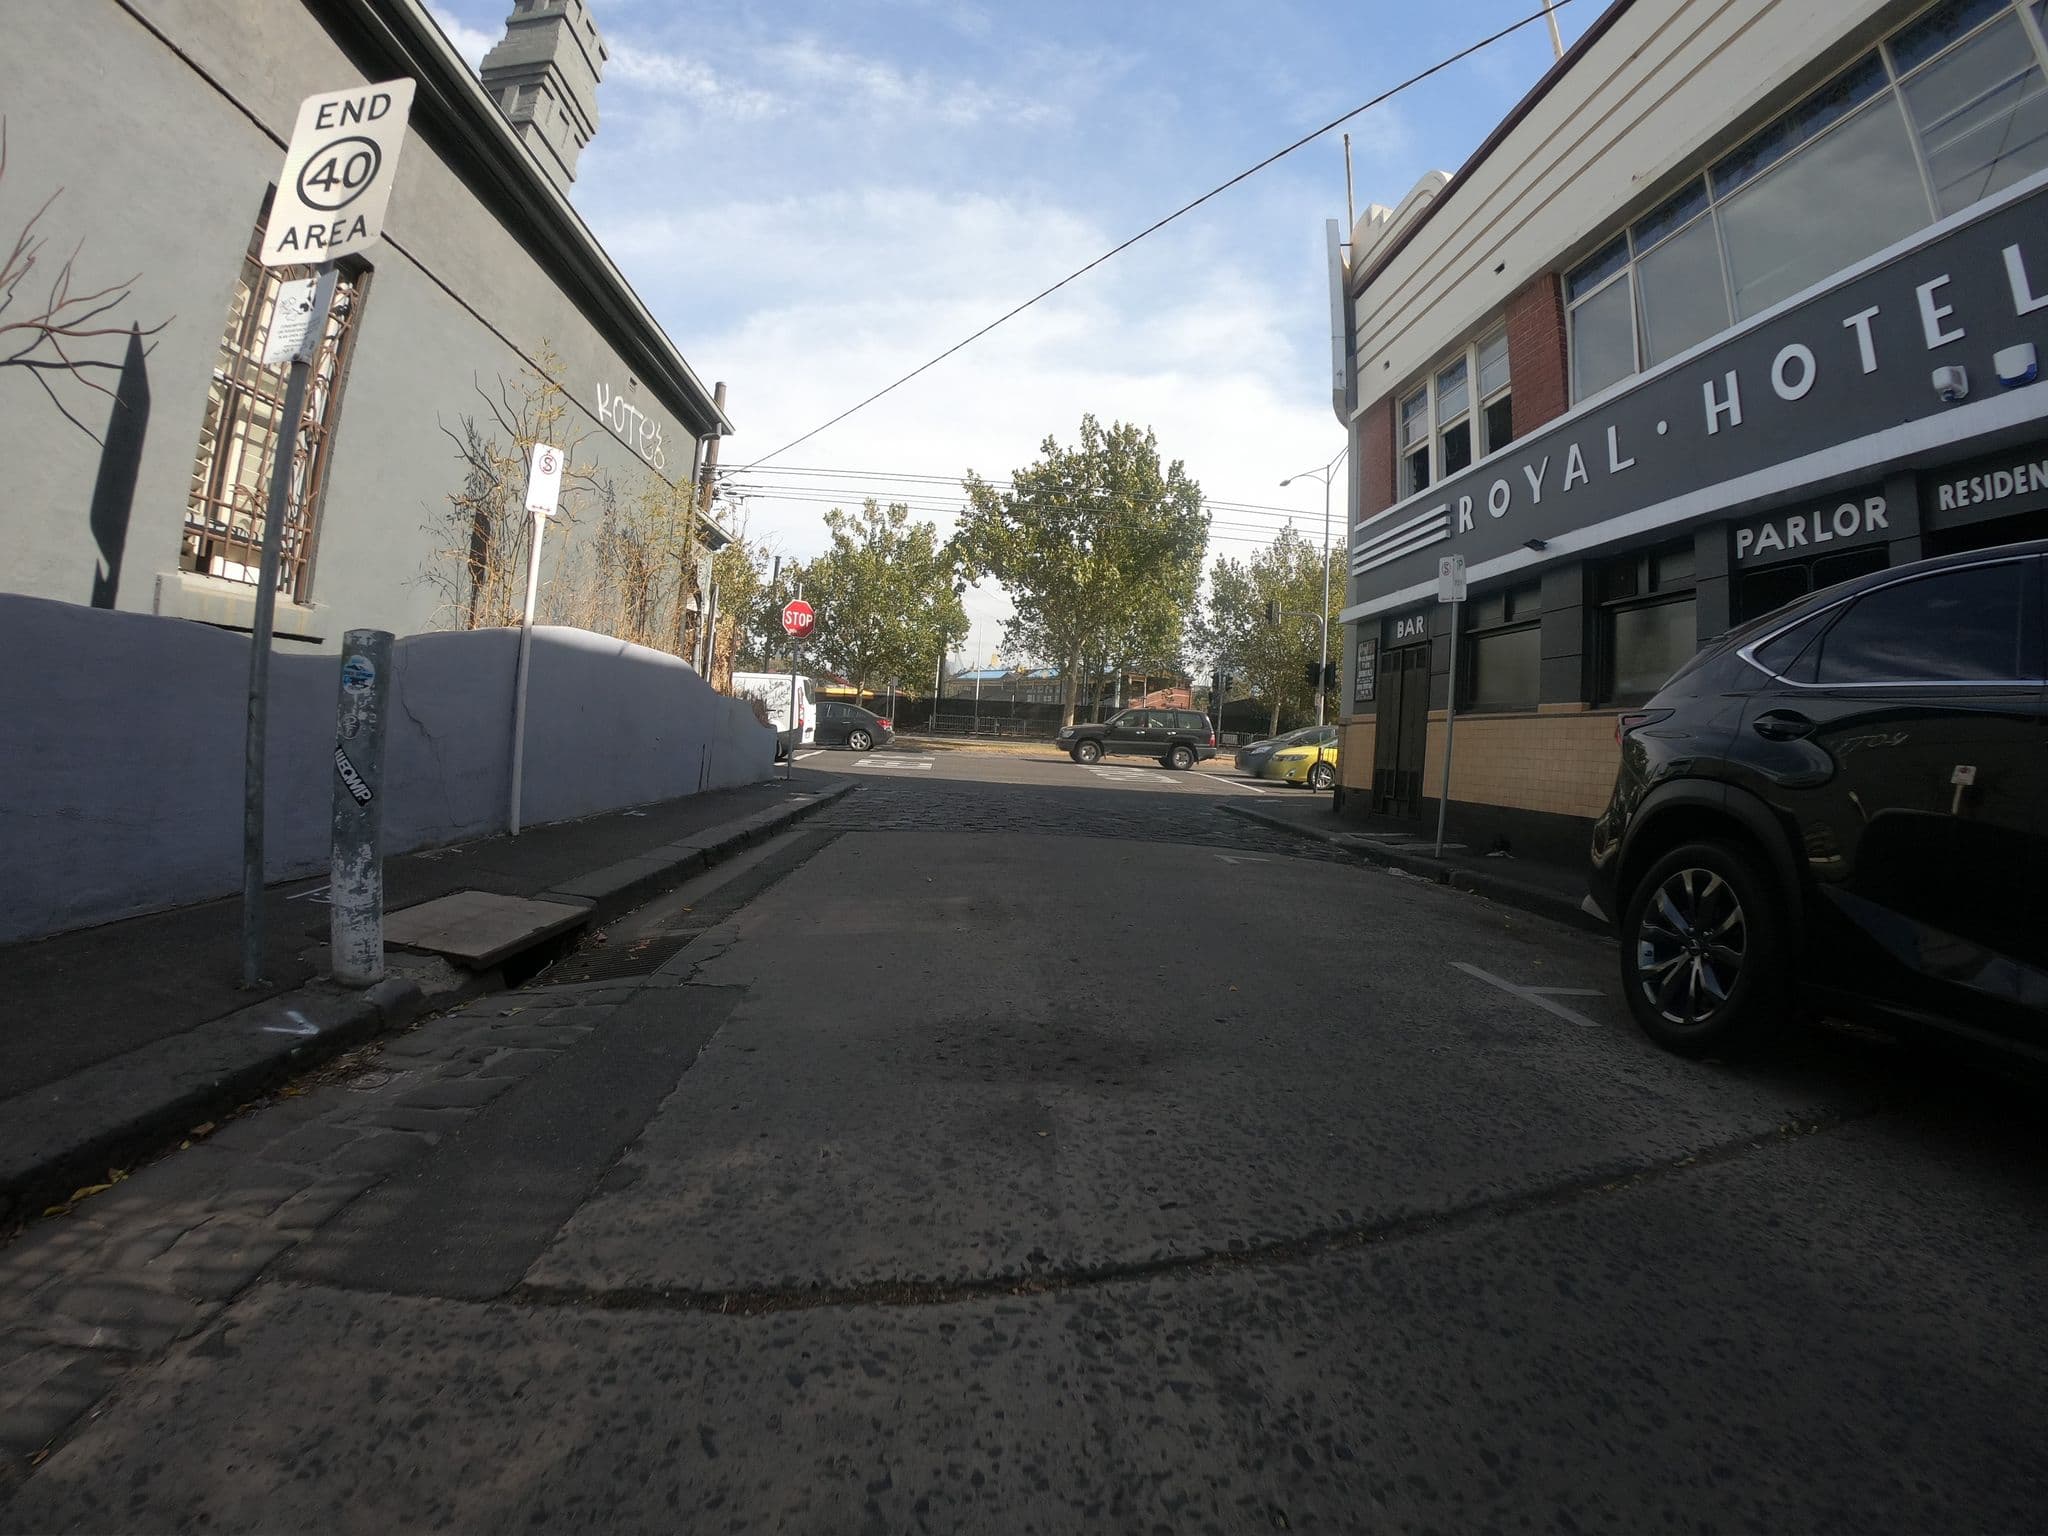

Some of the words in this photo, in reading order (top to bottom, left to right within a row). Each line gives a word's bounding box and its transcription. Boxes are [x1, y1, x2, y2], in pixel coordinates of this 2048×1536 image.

[315, 93, 391, 130] END
[306, 151, 372, 192] 40
[276, 215, 367, 252] AREA
[1458, 425, 1635, 534] ROYAL
[1703, 243, 2048, 435] HOTEL
[1938, 460, 2048, 511] RESIDEN
[1736, 496, 1889, 559] PARLOR
[785, 610, 813, 627] STOP
[1397, 616, 1424, 638] BAR
